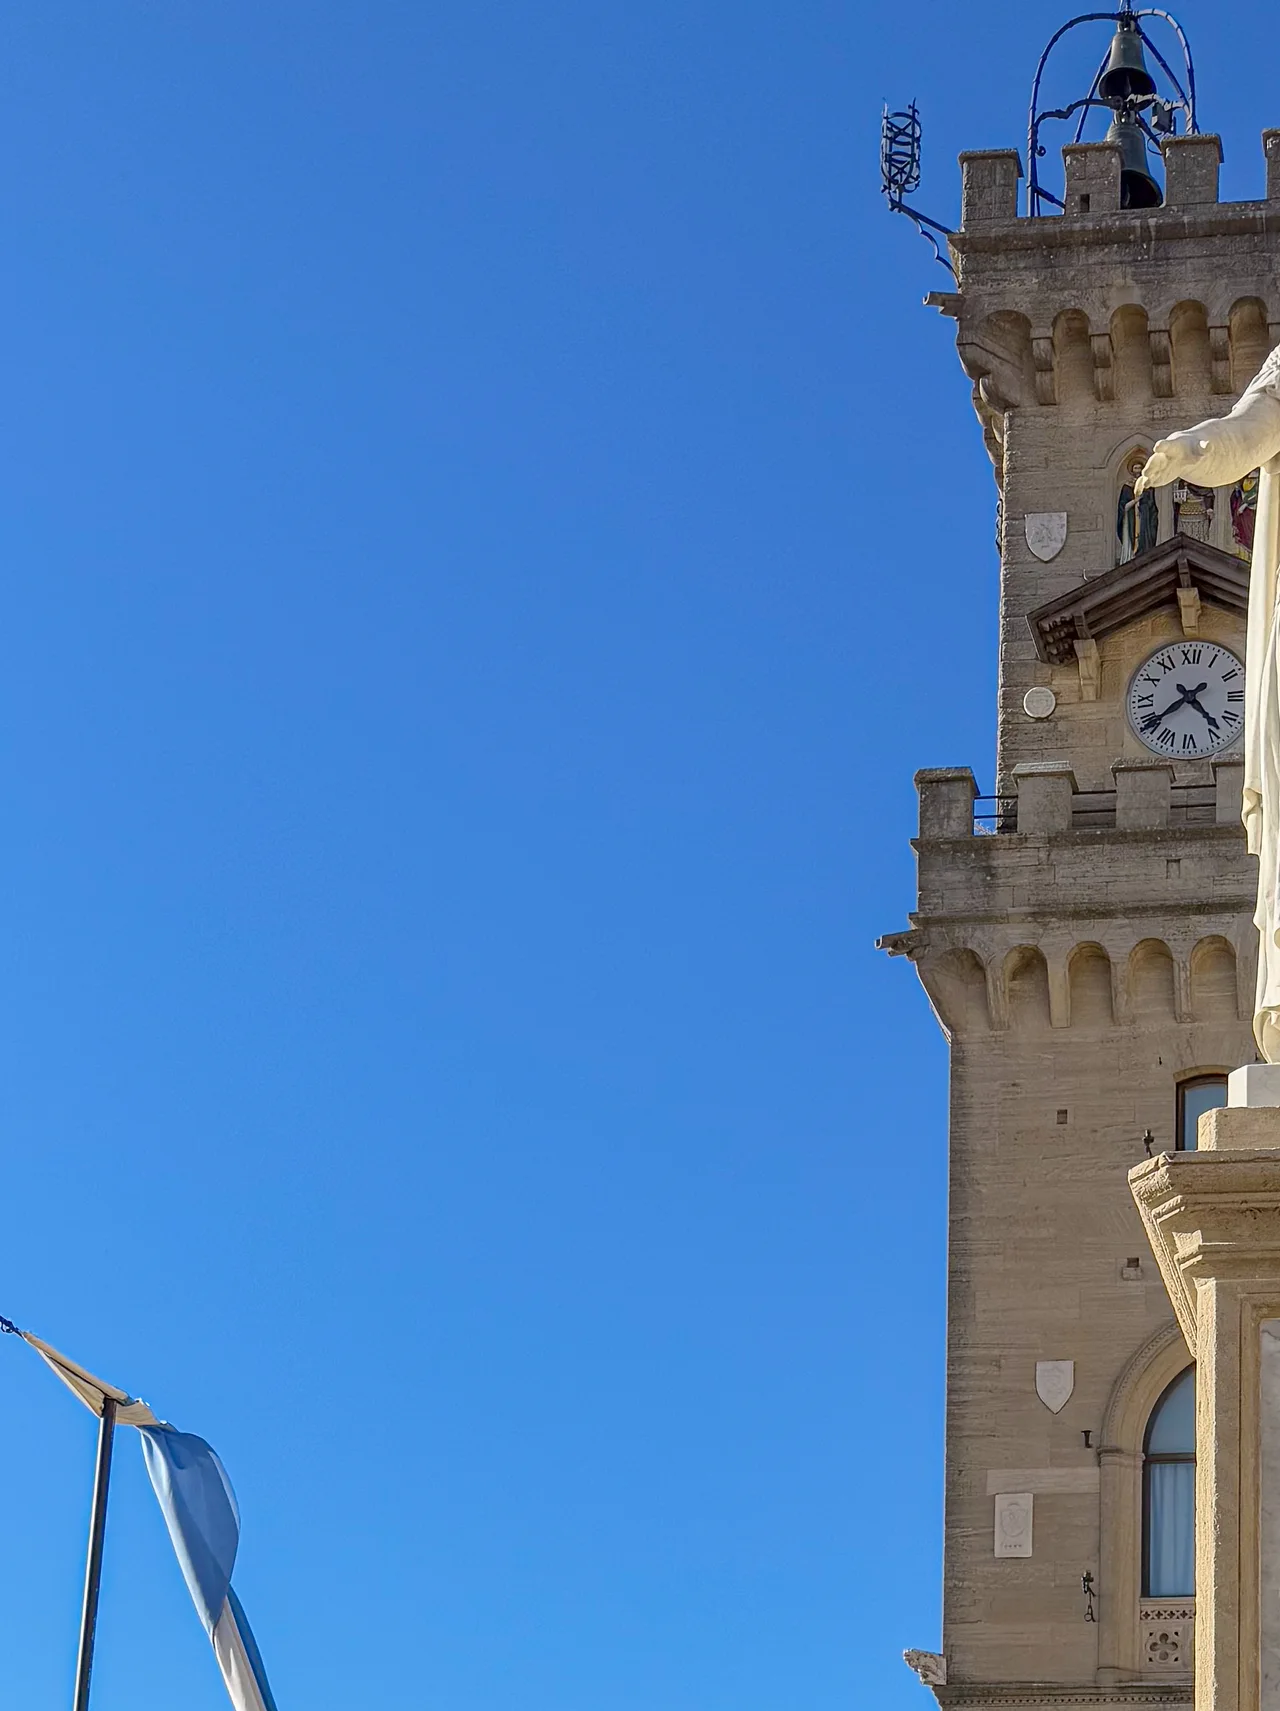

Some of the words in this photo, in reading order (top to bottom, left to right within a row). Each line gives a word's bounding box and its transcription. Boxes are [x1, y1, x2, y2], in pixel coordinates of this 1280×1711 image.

[1156, 654, 1176, 675] XI
[1181, 649, 1202, 665] XII
[1208, 653, 1219, 669] I
[1143, 673, 1161, 687] X
[1221, 668, 1239, 682] II
[1137, 693, 1154, 709] IX
[1227, 690, 1244, 702] III
[1221, 710, 1240, 728] IV
[1156, 727, 1176, 747] VII
[1182, 733, 1197, 750] VI
[1208, 728, 1221, 743] V
